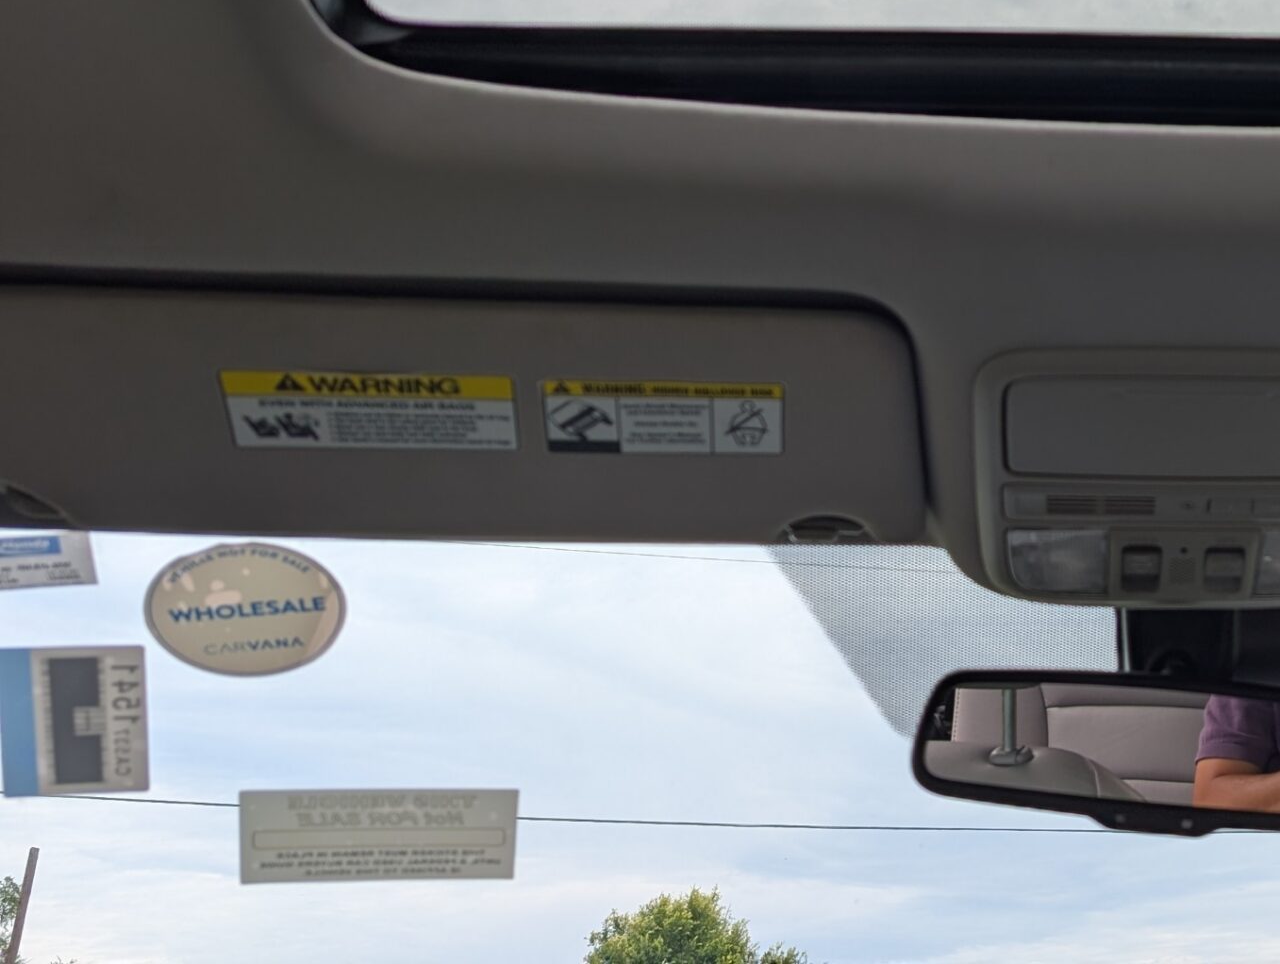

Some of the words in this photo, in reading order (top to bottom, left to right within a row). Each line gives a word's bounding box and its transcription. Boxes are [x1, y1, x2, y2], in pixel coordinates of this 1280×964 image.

[308, 376, 461, 395] WARNING
[250, 548, 279, 559] FOR
[168, 596, 327, 624] WHOLESALE
[203, 636, 305, 656] CARVANA
